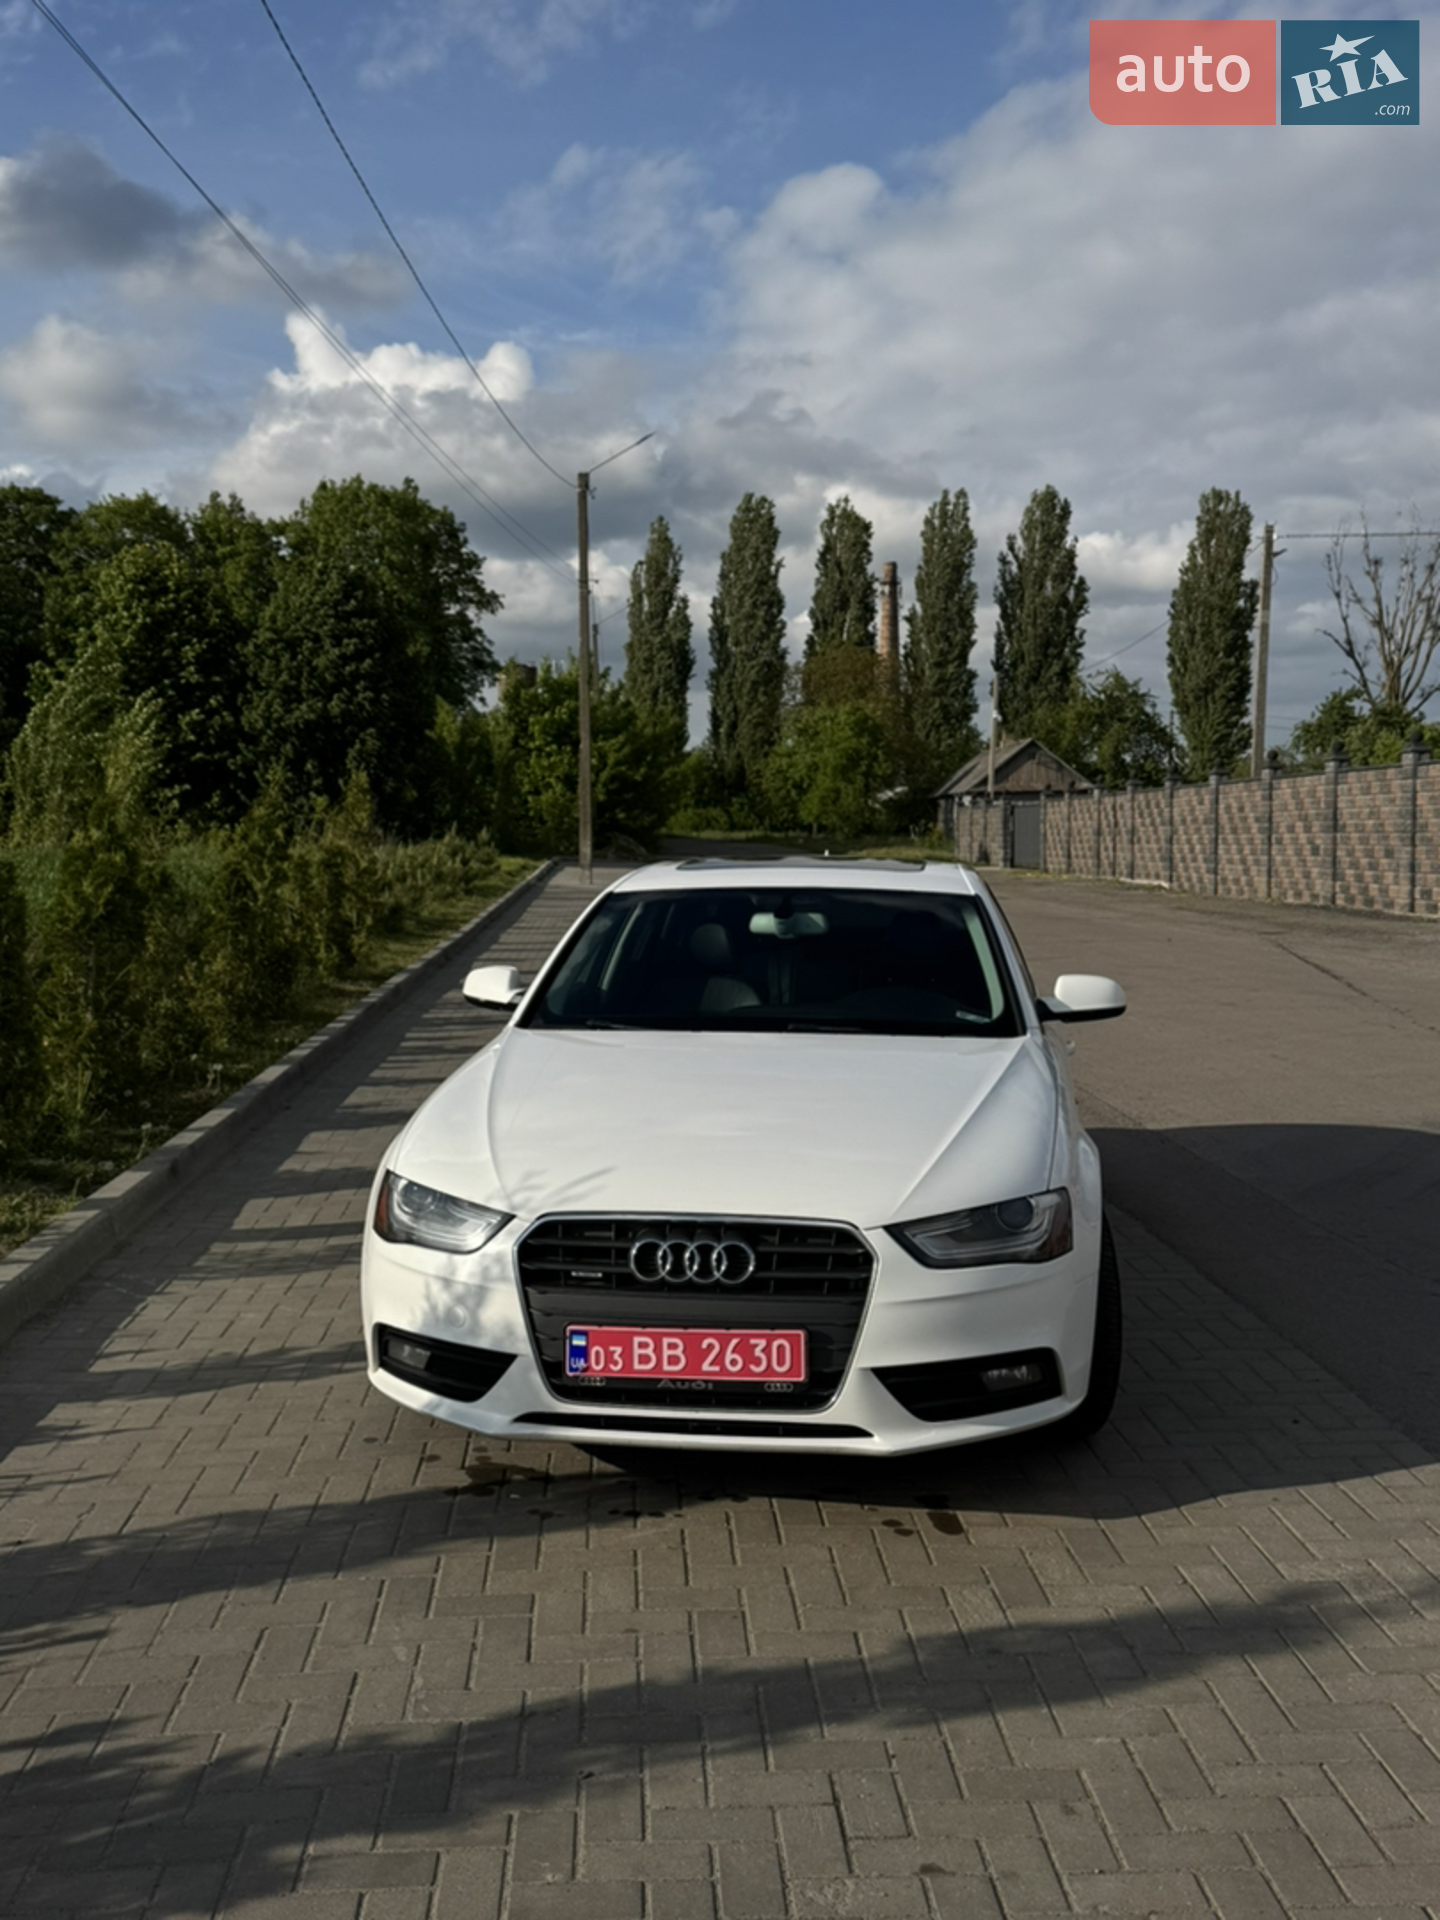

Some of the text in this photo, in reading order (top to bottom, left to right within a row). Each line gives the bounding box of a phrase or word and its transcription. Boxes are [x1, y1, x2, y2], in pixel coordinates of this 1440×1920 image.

[570, 1357, 587, 1369] UA
[590, 1336, 791, 1373] 03 BB 2630
